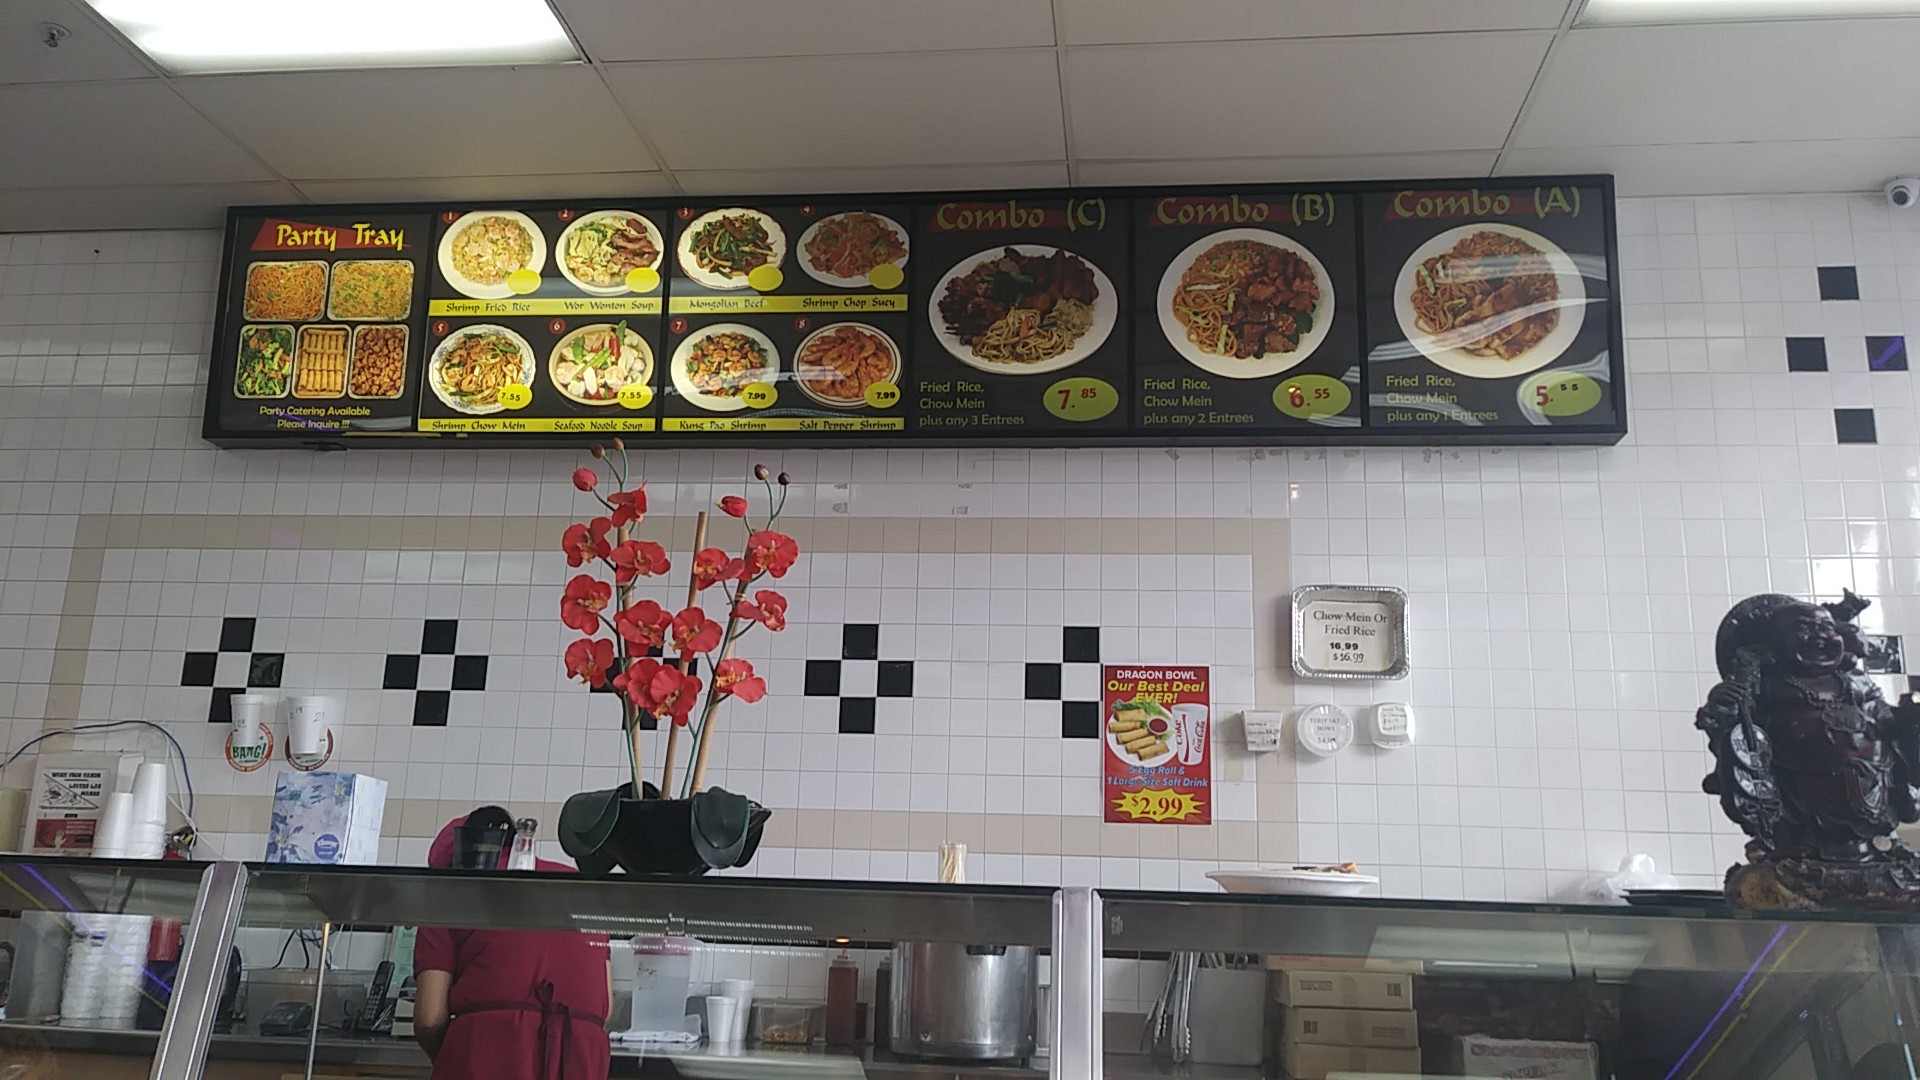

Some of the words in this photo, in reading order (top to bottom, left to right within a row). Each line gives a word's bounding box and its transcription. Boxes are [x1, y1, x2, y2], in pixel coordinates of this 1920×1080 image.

[1394, 188, 1511, 218] Combo
[1534, 186, 1581, 219] (A)
[936, 200, 1046, 230] Combo
[1066, 197, 1106, 232] (C)
[1157, 195, 1270, 225] Combo
[1291, 192, 1335, 227] (B)
[276, 224, 337, 251] Party
[352, 223, 404, 251] Tray
[446, 302, 480, 314] Shrimp
[485, 303, 508, 312] Fried
[512, 302, 531, 312] Rice
[564, 301, 585, 311] Wor
[590, 301, 626, 310] Wonton
[631, 300, 654, 311] Soup
[689, 299, 739, 311] Mongolian
[744, 298, 766, 308] Beef
[802, 297, 839, 309] Shrimp
[843, 297, 867, 308] Chop
[871, 297, 896, 308] Suey
[437, 323, 444, 332] 5
[553, 321, 560, 331] 6
[676, 321, 682, 330] 7
[799, 319, 806, 329] 8
[920, 381, 950, 392] Fried
[957, 381, 984, 393] Rice,
[1144, 378, 1175, 390] Fried
[1182, 378, 1211, 391] Rice,
[1386, 375, 1419, 387] Fried
[1426, 375, 1456, 388] Rice,
[501, 391, 521, 401] 7.55
[620, 391, 642, 399] 7.55
[747, 392, 767, 400] 7.99
[876, 391, 896, 399] 7.99
[1144, 396, 1179, 407] Chow
[1182, 395, 1212, 406] Mein
[1387, 392, 1423, 404] Chow
[1426, 392, 1457, 403] Mein
[920, 398, 953, 409] Chow
[956, 397, 985, 408] Mein
[259, 406, 285, 417] Party
[287, 406, 326, 418] Catering
[327, 406, 371, 416] Available
[1388, 410, 1412, 423] plus
[1416, 411, 1440, 422] any
[1452, 410, 1498, 420] Entrees
[277, 419, 306, 429] Please
[308, 419, 340, 430] Inquire
[919, 415, 942, 427] plus
[946, 416, 968, 427] any
[982, 414, 1024, 425] Entrees
[1144, 412, 1168, 425] plus
[1172, 414, 1195, 425] any
[1209, 412, 1254, 423] Entrees
[432, 421, 466, 431] Shrimp
[471, 421, 498, 430] Chow
[502, 421, 526, 430] Mein
[554, 421, 586, 430] Seafood
[590, 421, 618, 430] Noodle
[622, 421, 643, 431] Soup
[679, 421, 704, 431] Kung
[710, 421, 725, 430] Pao
[730, 421, 767, 431] Shrimp
[799, 421, 818, 430] Salt
[823, 421, 855, 431] Pepper
[860, 421, 897, 431] Shrimp
[1313, 610, 1343, 620] Chow
[1345, 612, 1371, 622] Mein
[1374, 613, 1388, 623] Or
[1324, 624, 1350, 635] Fried
[1353, 626, 1376, 636] Rice
[1329, 642, 1359, 651] 16.99
[1117, 670, 1162, 679] DRAGON
[1165, 671, 1197, 680] BOWL
[1107, 680, 1134, 691] Our
[1137, 681, 1169, 692] Best
[1172, 681, 1205, 692] Deal
[1135, 692, 1178, 703] EVER!
[232, 743, 267, 759] BANG!
[1129, 765, 1136, 773] 5
[1138, 766, 1154, 776] Egg
[1158, 766, 1176, 774] Roll
[1178, 766, 1185, 774] &
[1114, 777, 1138, 787] Large
[1142, 778, 1160, 786] Size
[1163, 777, 1181, 787] Soft
[1183, 778, 1208, 787] Drink
[1131, 795, 1183, 816] $2.99
